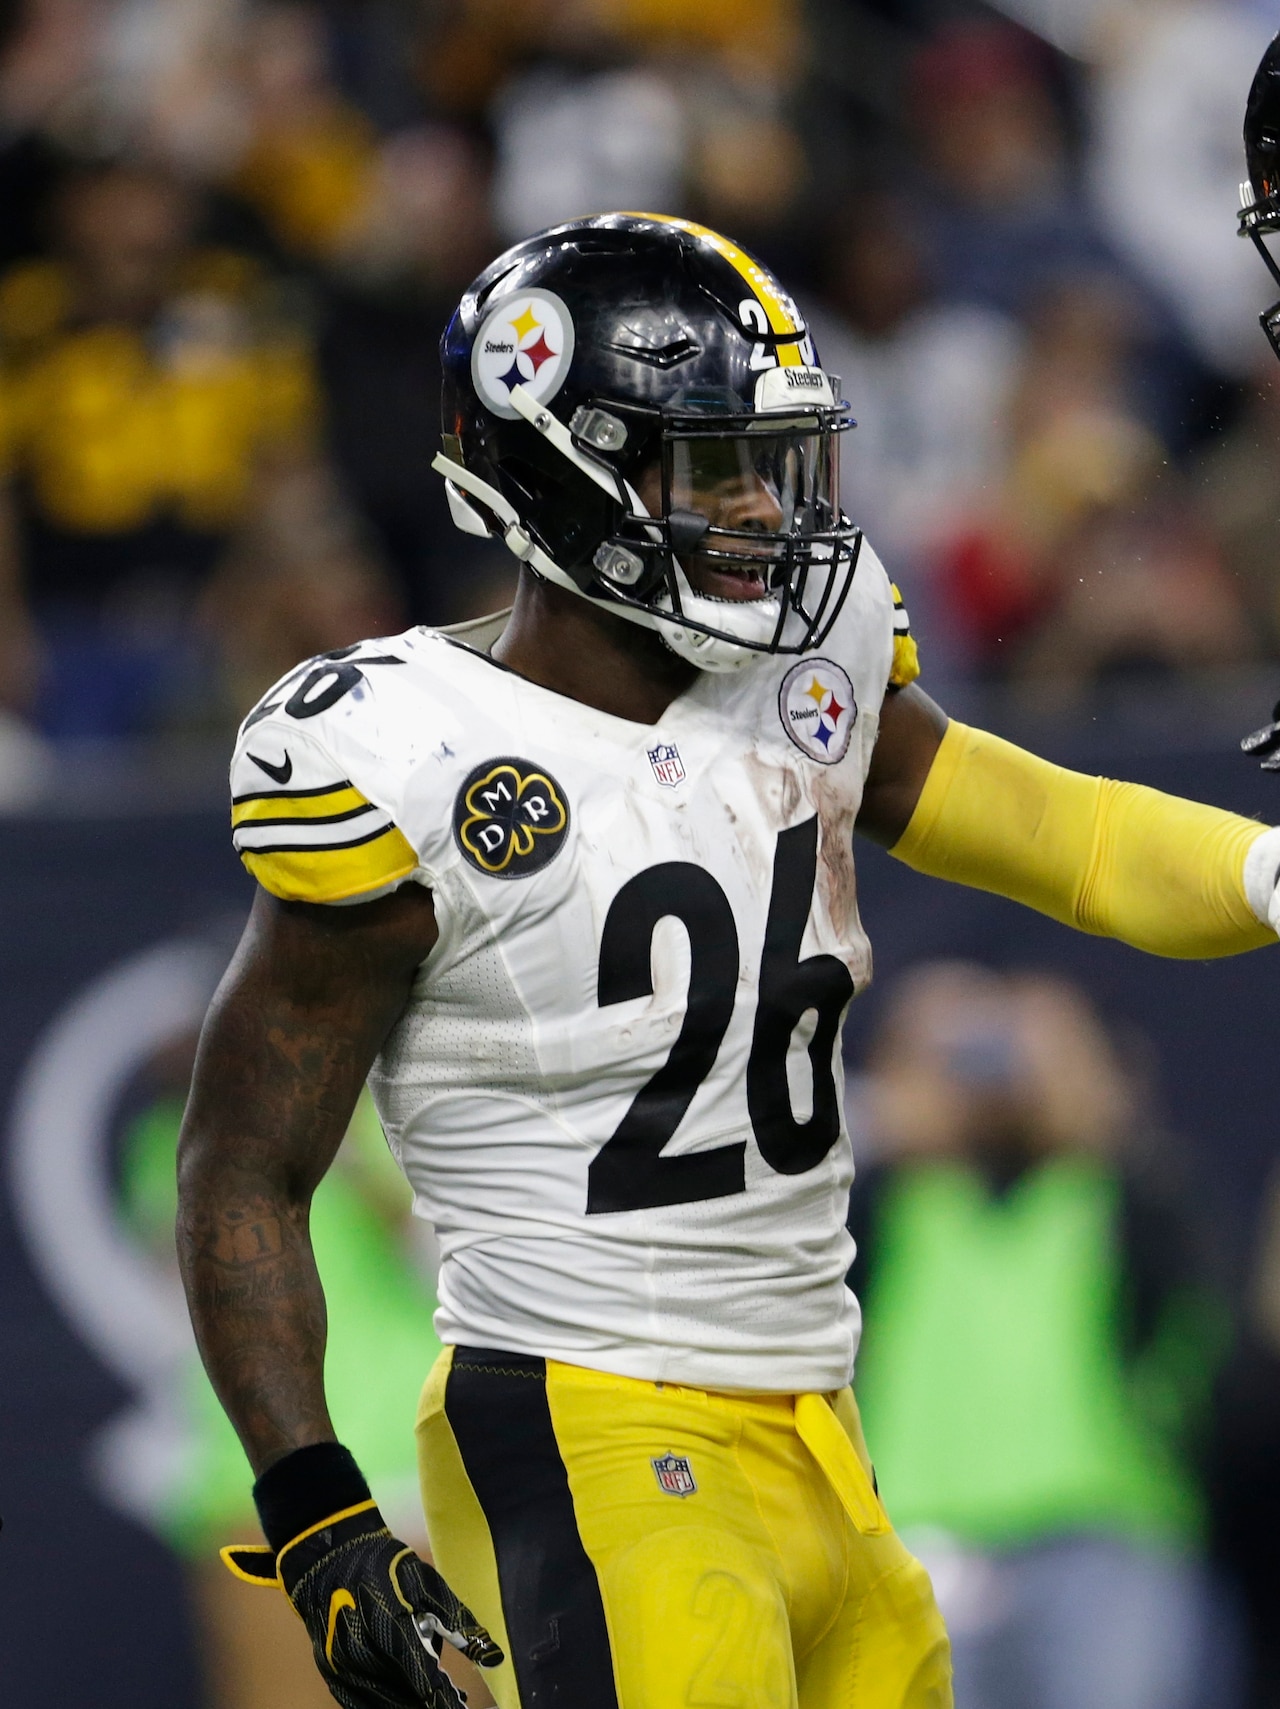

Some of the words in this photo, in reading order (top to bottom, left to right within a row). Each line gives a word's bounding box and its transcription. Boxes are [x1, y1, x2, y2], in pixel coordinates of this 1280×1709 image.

[738, 297, 816, 371] 26
[484, 340, 514, 353] Steelers
[784, 367, 823, 388] Steelers
[790, 707, 818, 721] Steelers
[655, 760, 683, 783] NFL
[586, 813, 855, 1215] 26
[662, 1471, 691, 1490] NFL
